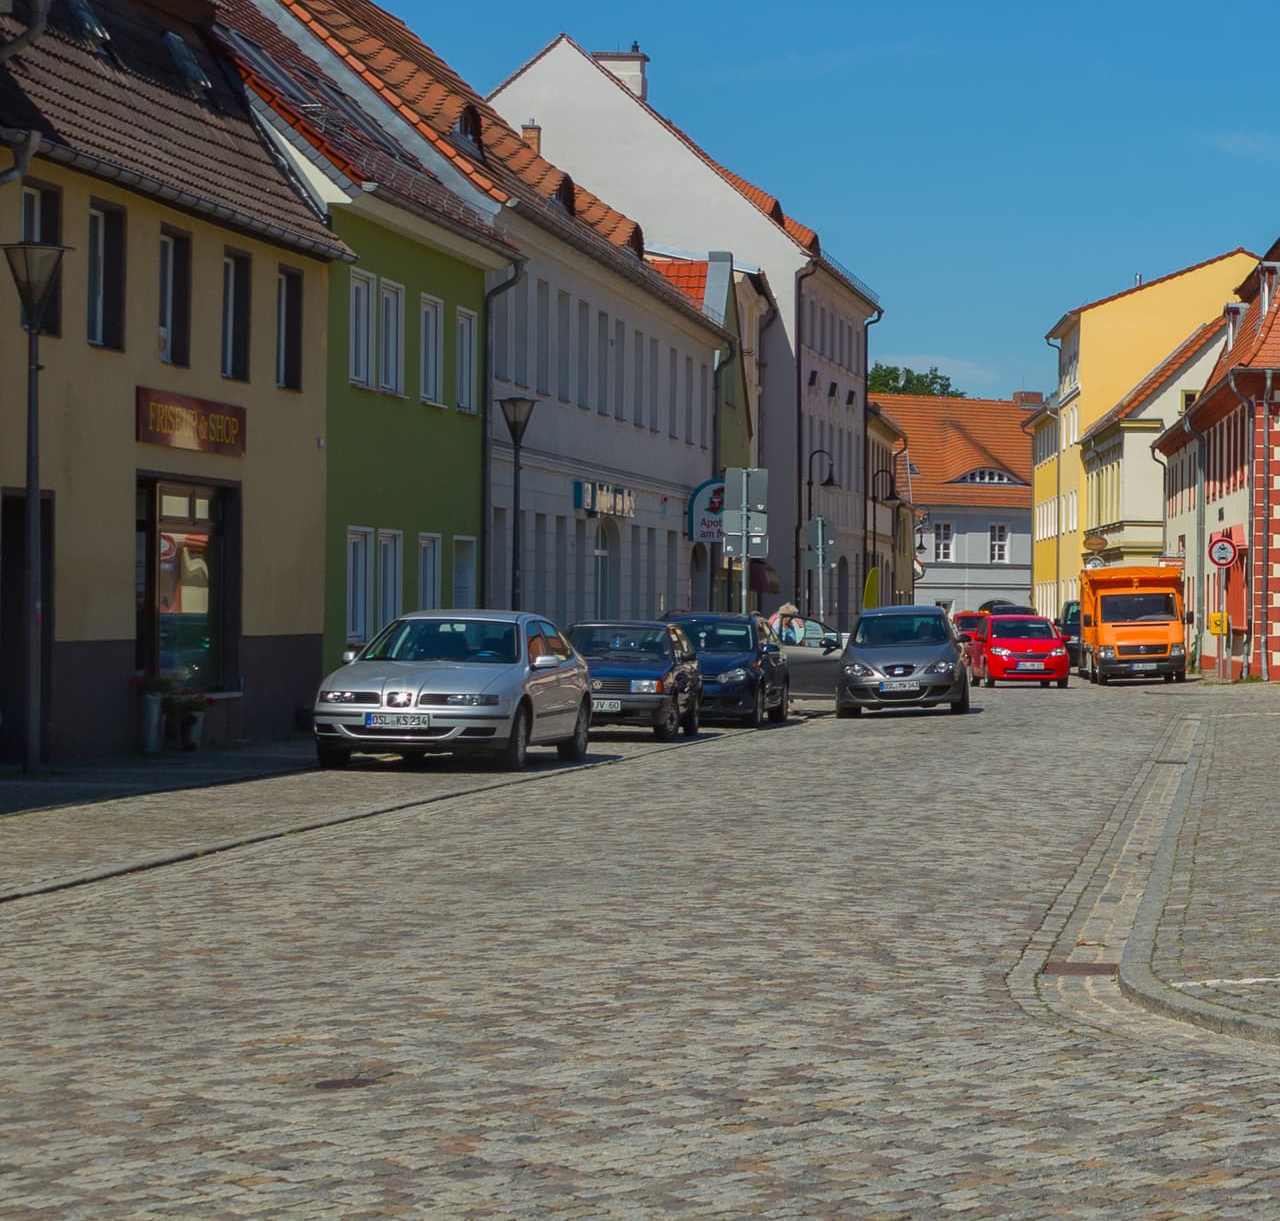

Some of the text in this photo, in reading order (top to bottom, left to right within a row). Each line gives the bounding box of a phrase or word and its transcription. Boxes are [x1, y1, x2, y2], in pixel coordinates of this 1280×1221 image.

[148, 401, 239, 444] FRISEUR & SHOP
[700, 530, 714, 538] am
[372, 714, 427, 726] OSL KS 214
